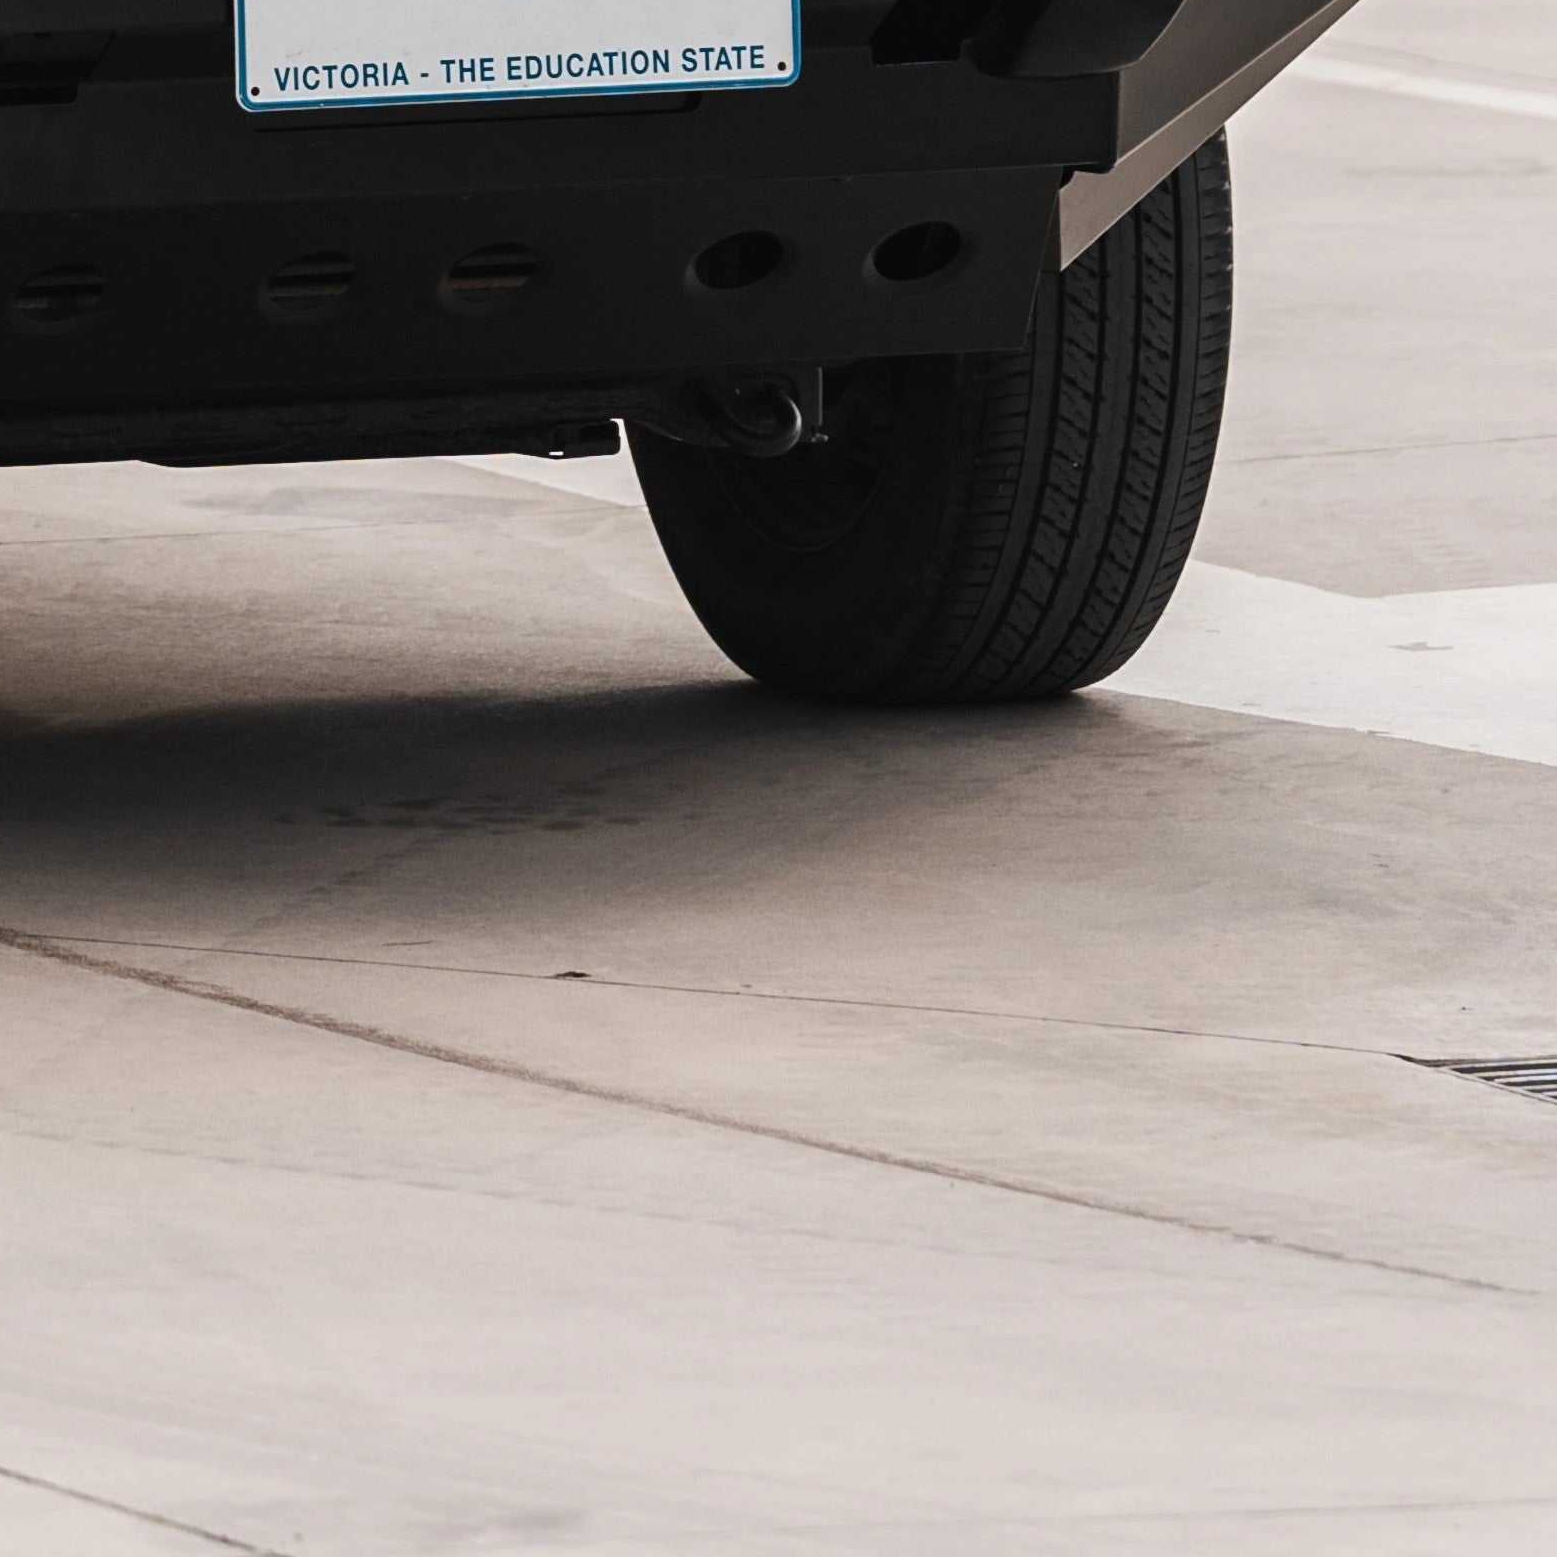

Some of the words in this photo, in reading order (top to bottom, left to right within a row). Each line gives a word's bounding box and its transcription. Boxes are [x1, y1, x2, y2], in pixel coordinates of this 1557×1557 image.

[274, 62, 409, 91] VICTORIA
[440, 57, 495, 83] THE
[506, 49, 670, 81] EDUCATION
[681, 45, 765, 73] STATE
